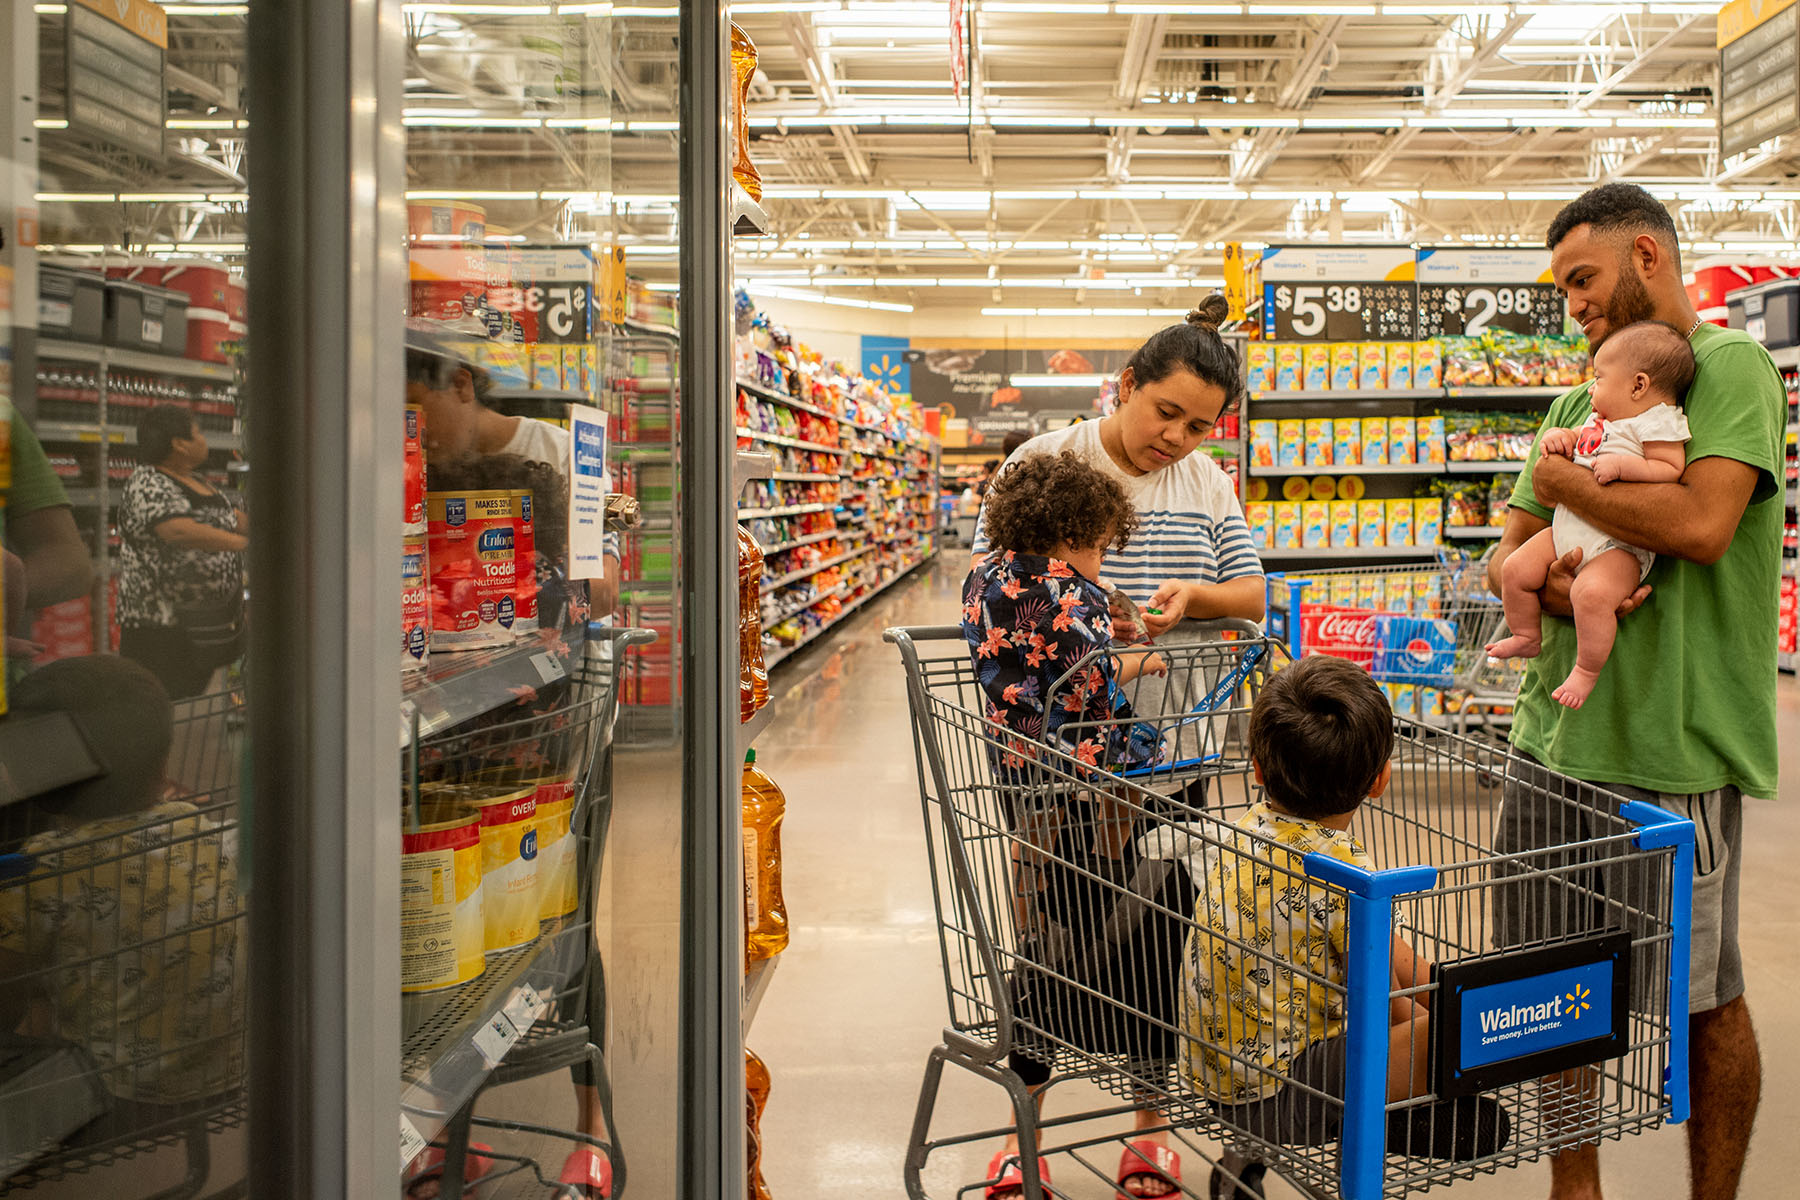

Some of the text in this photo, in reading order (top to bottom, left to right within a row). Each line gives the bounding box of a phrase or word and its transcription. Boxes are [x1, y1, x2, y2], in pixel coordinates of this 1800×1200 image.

[475, 499, 498, 508] MAKES
[511, 804, 531, 817] OVER
[1479, 995, 1562, 1034] Walmart
[1481, 1020, 1563, 1046] Save money. Live better.
